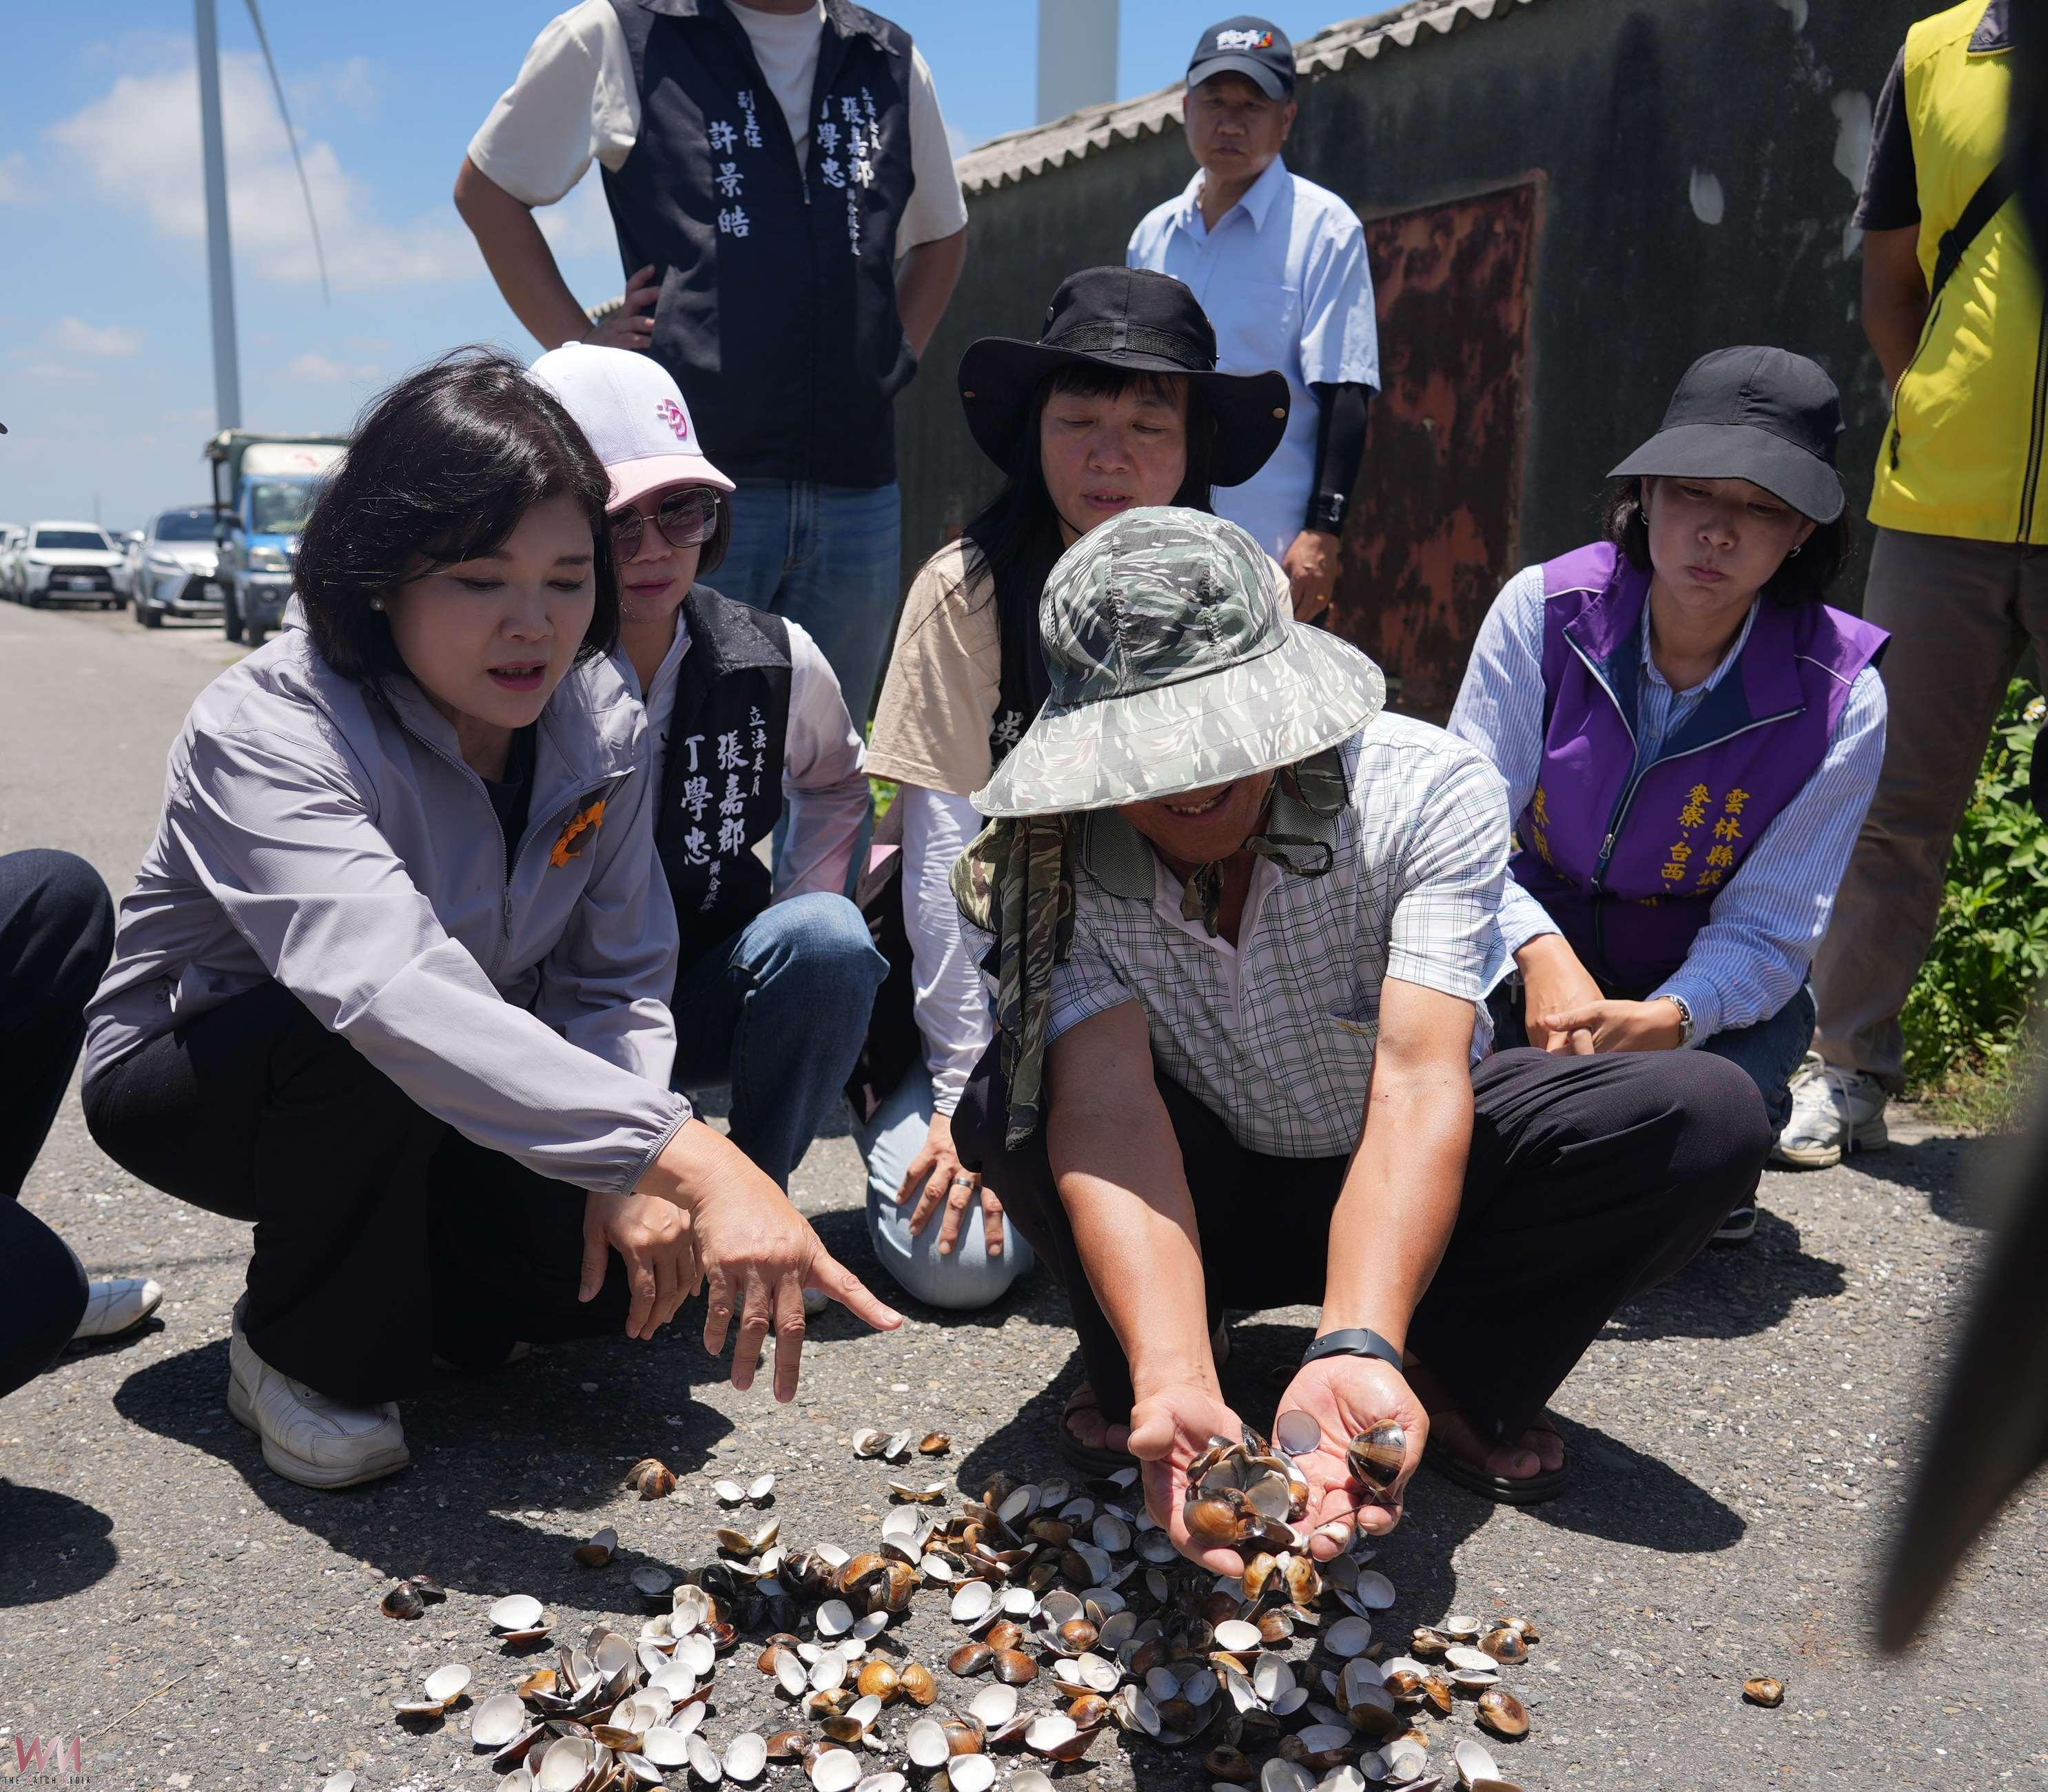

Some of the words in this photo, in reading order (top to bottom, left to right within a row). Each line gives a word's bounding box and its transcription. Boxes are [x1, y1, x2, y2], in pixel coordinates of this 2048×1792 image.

[708, 120, 750, 238] 許景皓
[841, 96, 874, 189] 張嘉郡
[680, 734, 713, 866] 丁學忠
[717, 729, 750, 857] 張嘉郡
[748, 706, 767, 796] 立法委員
[699, 859, 721, 913] 聯合服務
[1694, 787, 1751, 894] 雲林縣議
